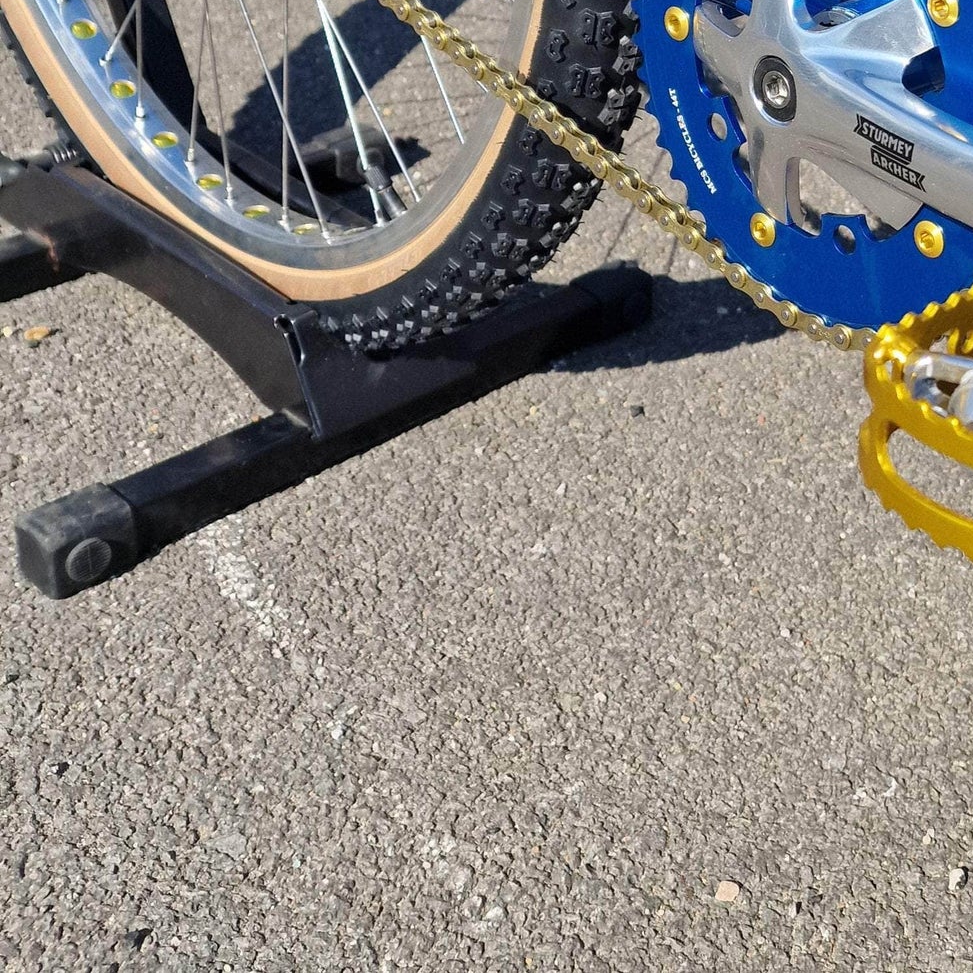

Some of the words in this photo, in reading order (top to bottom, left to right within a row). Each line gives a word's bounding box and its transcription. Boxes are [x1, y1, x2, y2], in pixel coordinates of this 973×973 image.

[668, 87, 679, 108] 44T
[676, 114, 704, 170] BICYCLES
[861, 121, 913, 158] STURMEY
[700, 169, 718, 195] MCS
[873, 152, 918, 185] ARCHER
